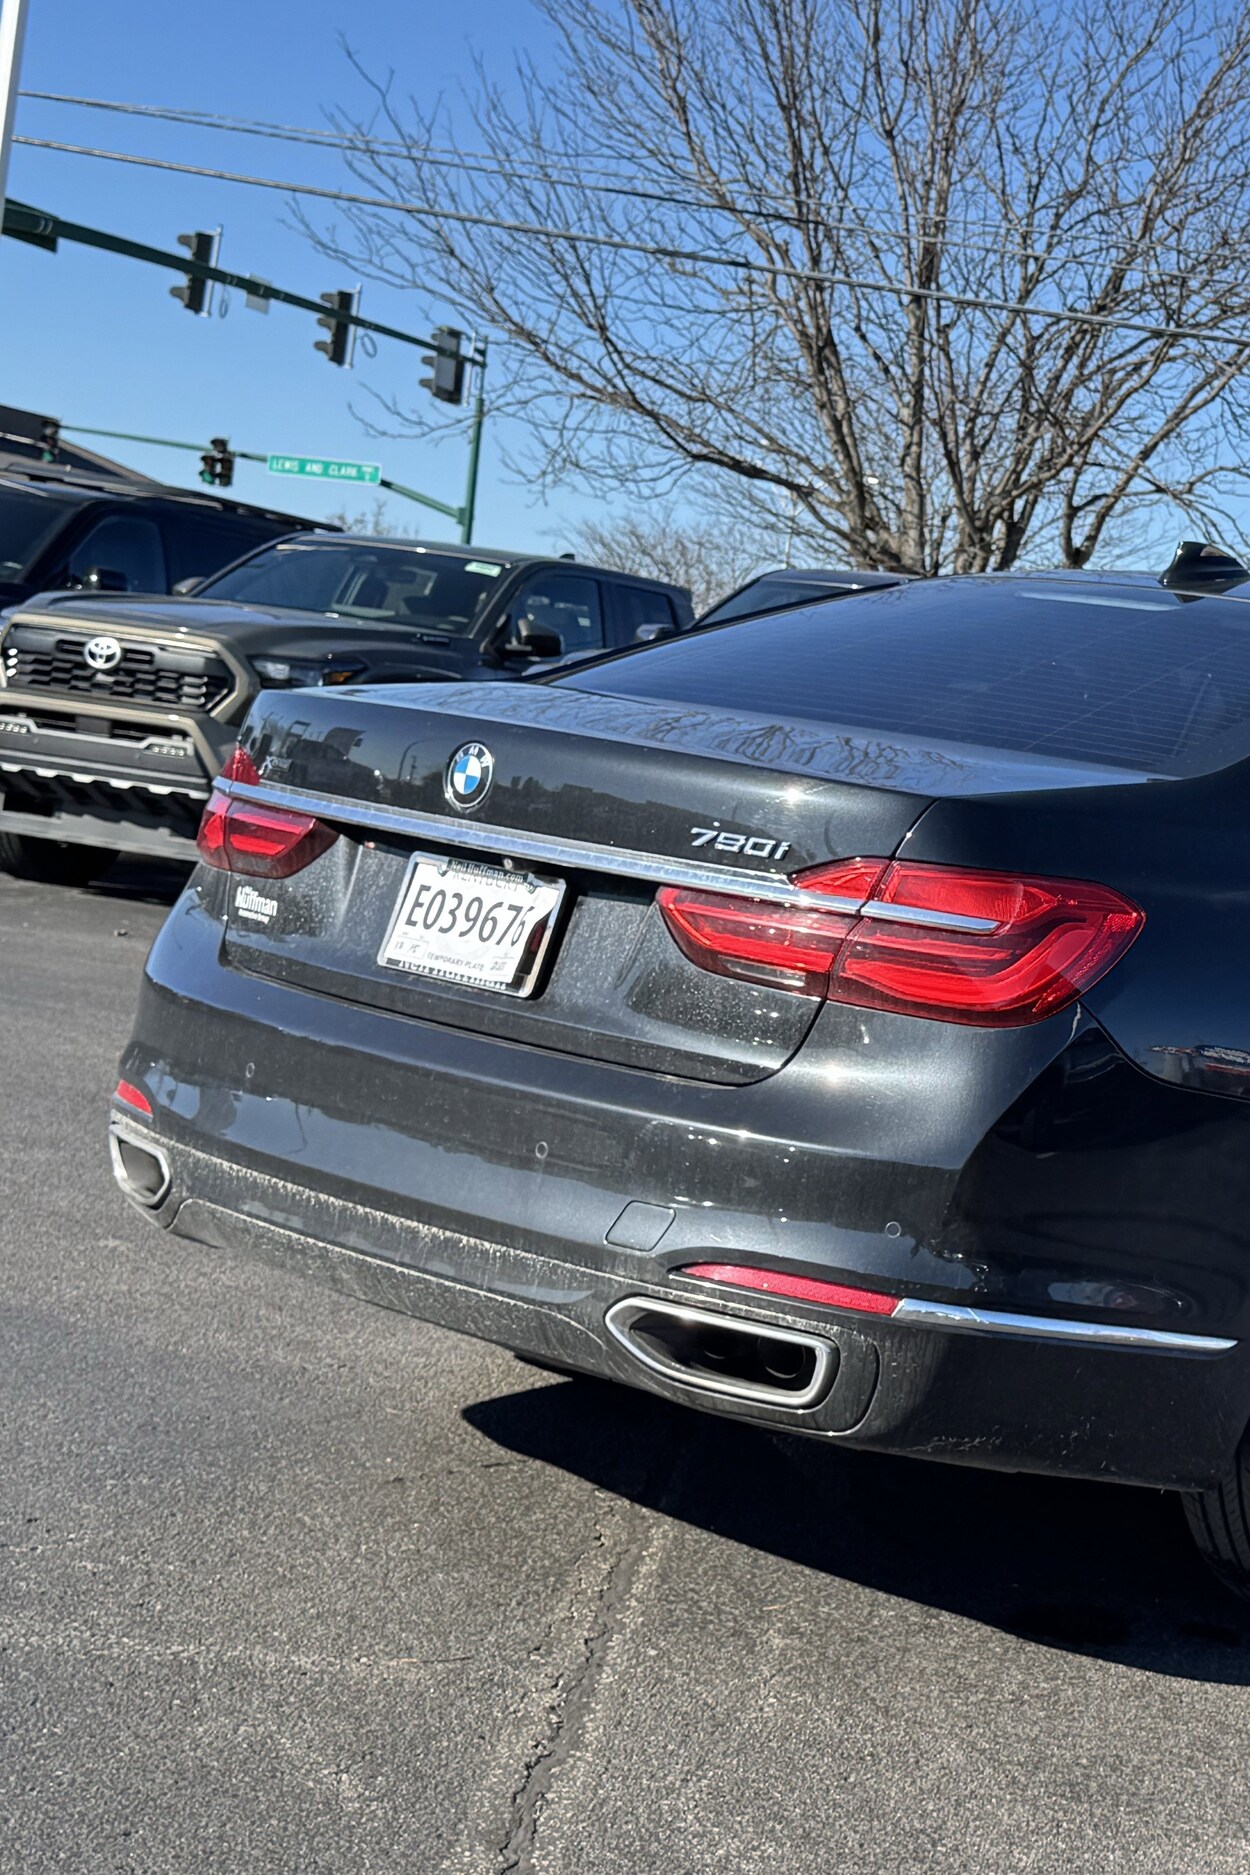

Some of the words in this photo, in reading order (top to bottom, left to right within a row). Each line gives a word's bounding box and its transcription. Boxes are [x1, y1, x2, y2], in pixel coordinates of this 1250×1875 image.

[272, 458, 299, 472] LEWIS
[305, 462, 323, 475] AND
[328, 464, 358, 478] CLARK
[690, 827, 791, 860] 750i
[404, 884, 535, 948] E039676
